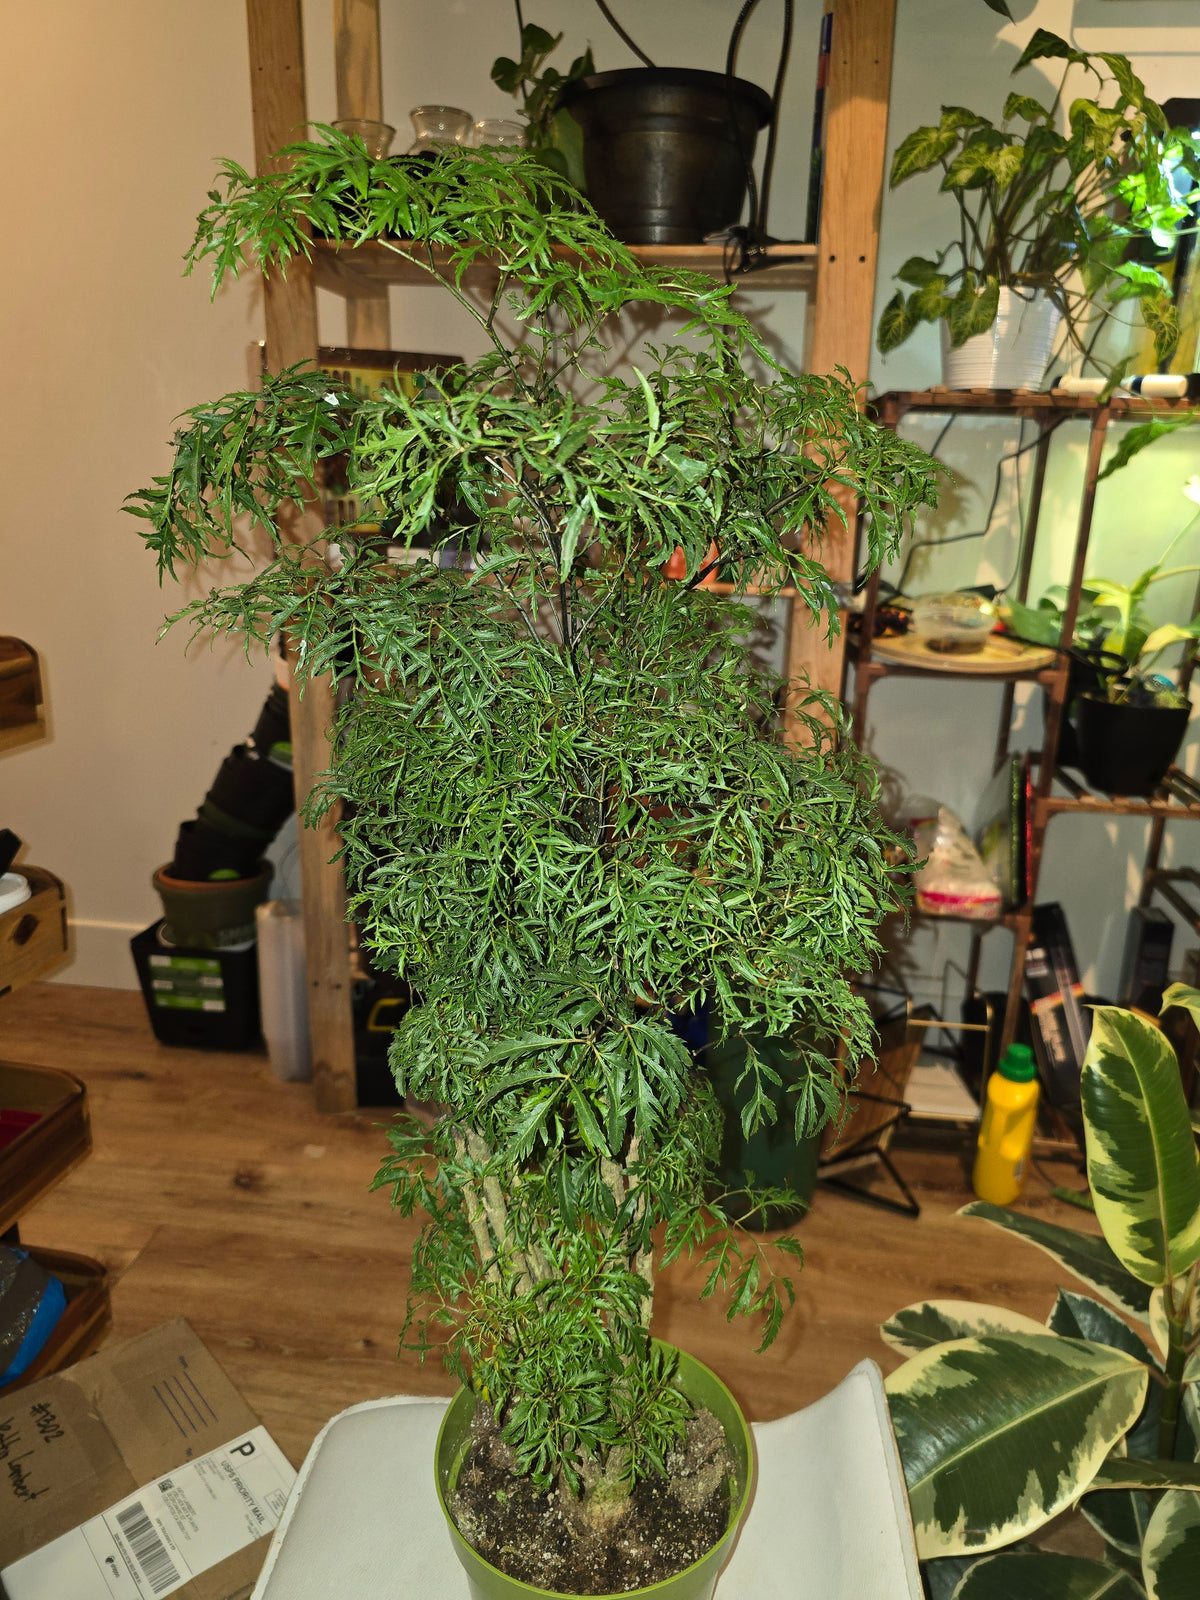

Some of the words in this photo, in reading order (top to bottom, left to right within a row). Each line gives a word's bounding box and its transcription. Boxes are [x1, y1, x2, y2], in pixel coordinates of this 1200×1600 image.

[229, 1440, 256, 1457] P
[220, 1460, 236, 1479] USPS
[232, 1477, 255, 1507] PRIORITY
[251, 1506, 265, 1525] MAIL
